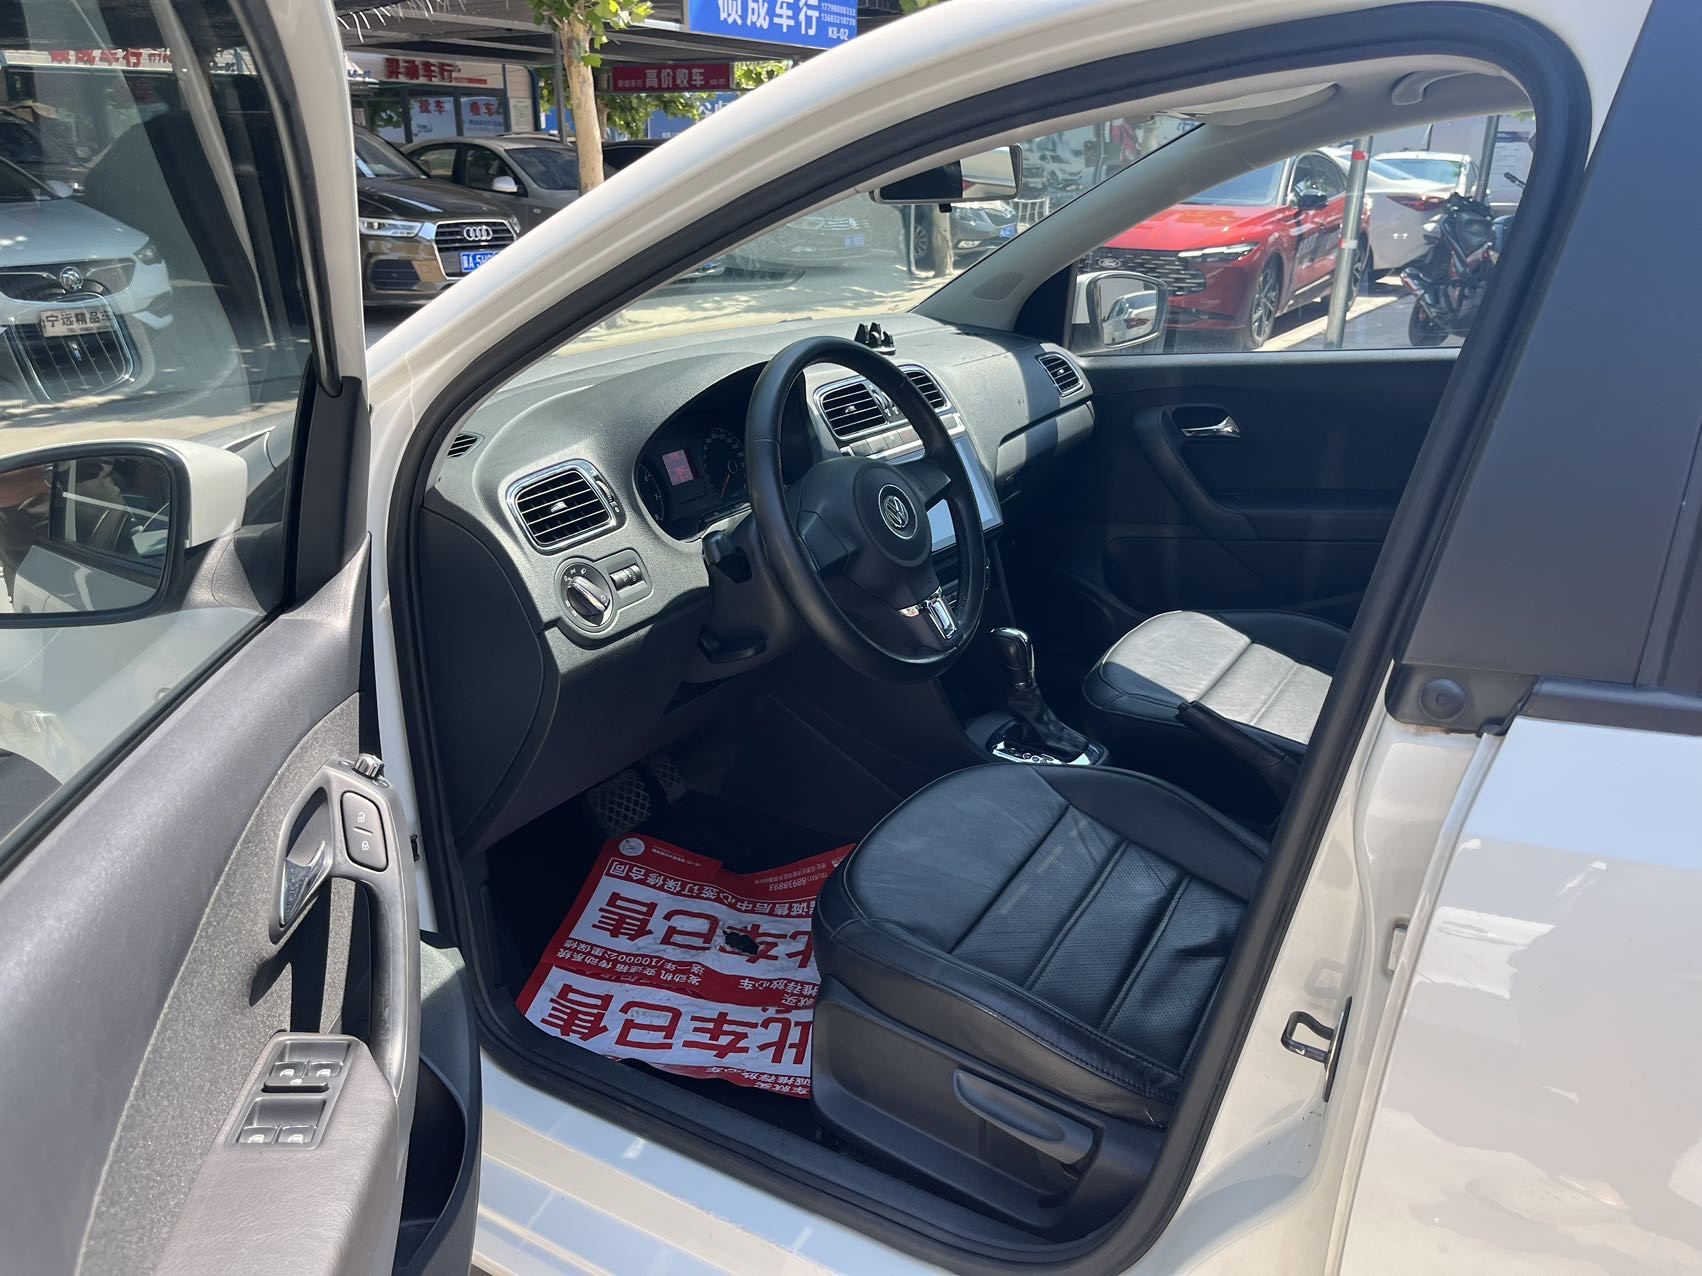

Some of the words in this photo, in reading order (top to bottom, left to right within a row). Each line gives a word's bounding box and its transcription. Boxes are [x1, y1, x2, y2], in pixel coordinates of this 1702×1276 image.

[645, 68, 705, 88] 高价收车
[610, 861, 816, 916] 诚售后中心签订保修合同
